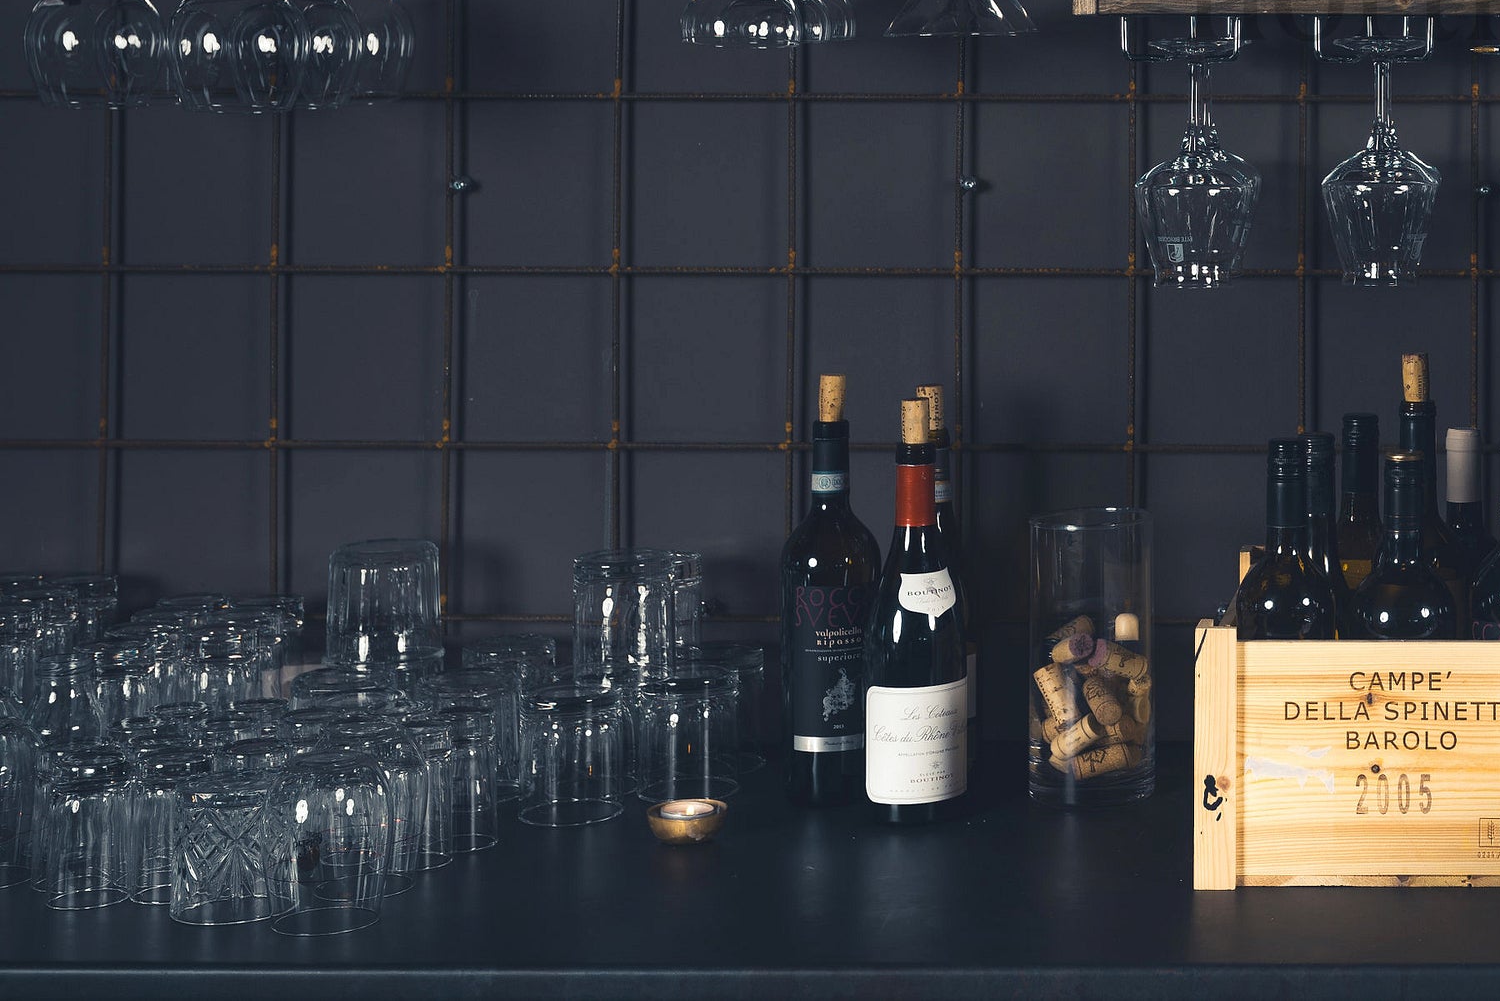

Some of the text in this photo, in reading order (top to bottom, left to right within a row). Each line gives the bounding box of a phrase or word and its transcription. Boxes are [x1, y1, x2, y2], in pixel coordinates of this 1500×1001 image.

[1284, 701, 1371, 721] DELLA
[900, 731, 913, 743] du
[914, 725, 949, 743] Rhône
[1345, 730, 1458, 751] BAROLO
[1355, 772, 1434, 816] 2005
